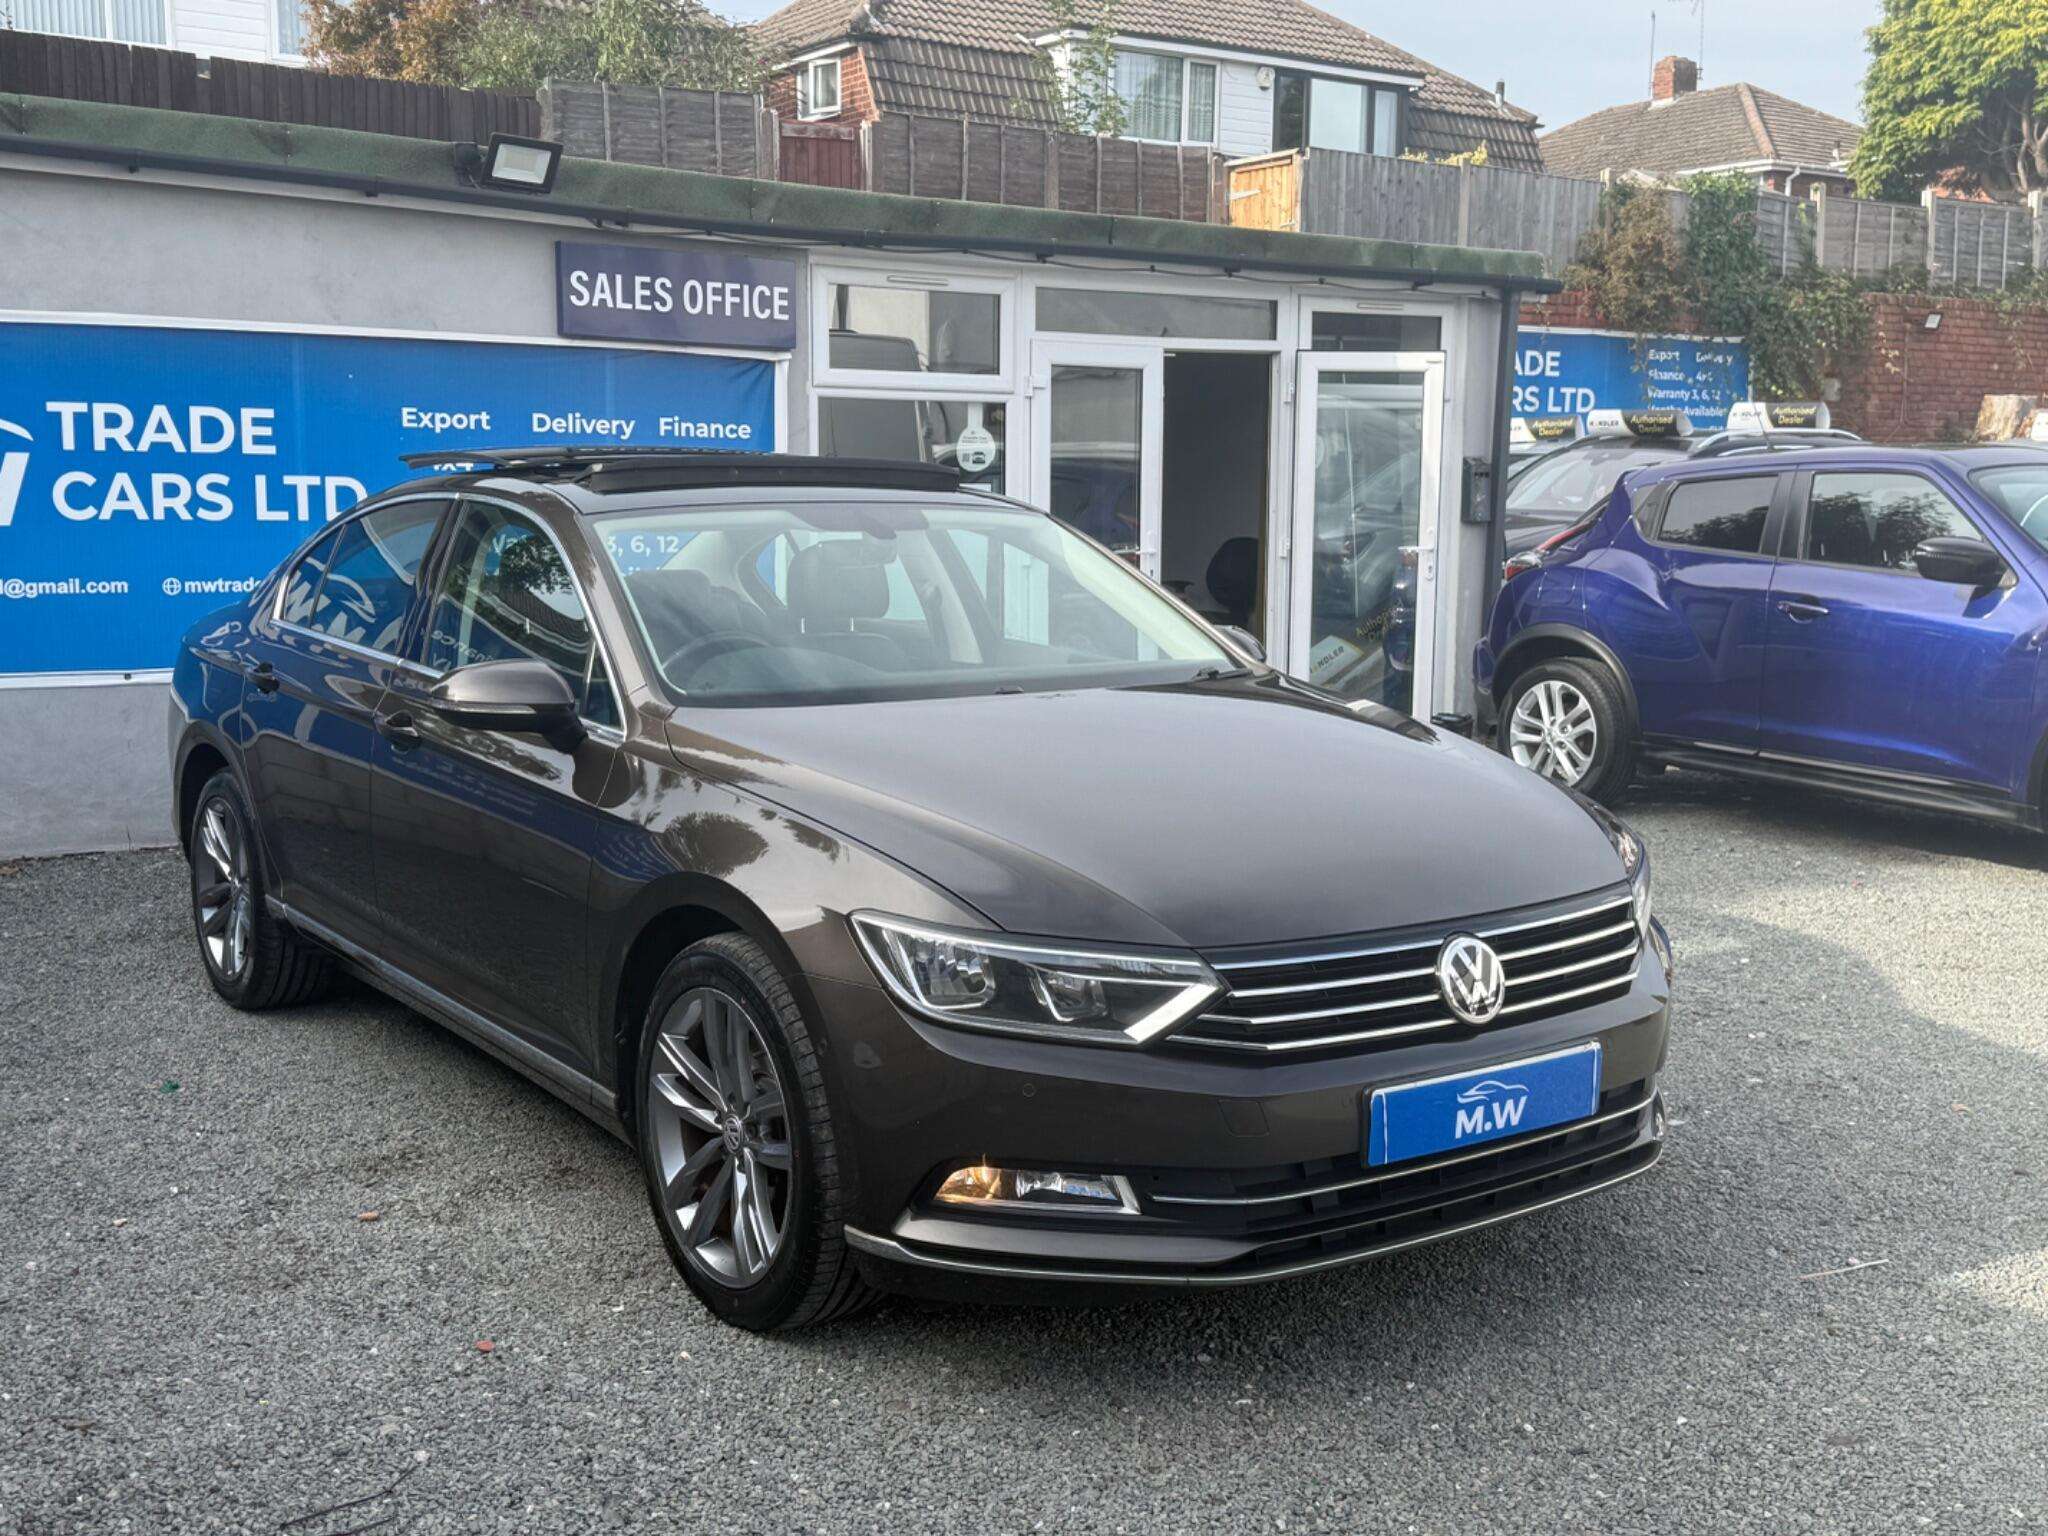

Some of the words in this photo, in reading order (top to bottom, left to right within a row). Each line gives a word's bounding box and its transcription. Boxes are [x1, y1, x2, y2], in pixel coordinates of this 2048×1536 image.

[569, 270, 673, 313] SALES
[683, 279, 790, 321] OFFICE
[1648, 349, 1680, 362] Export
[1547, 386, 1595, 413] LTD
[45, 401, 277, 455] TRADE
[401, 407, 491, 434] Export
[531, 412, 635, 439] Delivery
[658, 416, 752, 439] Finance
[52, 471, 234, 521] CARS
[254, 474, 369, 521] LTD
[630, 535, 651, 557] 6,
[656, 535, 679, 553] 12
[1455, 1095, 1528, 1139] M.W
